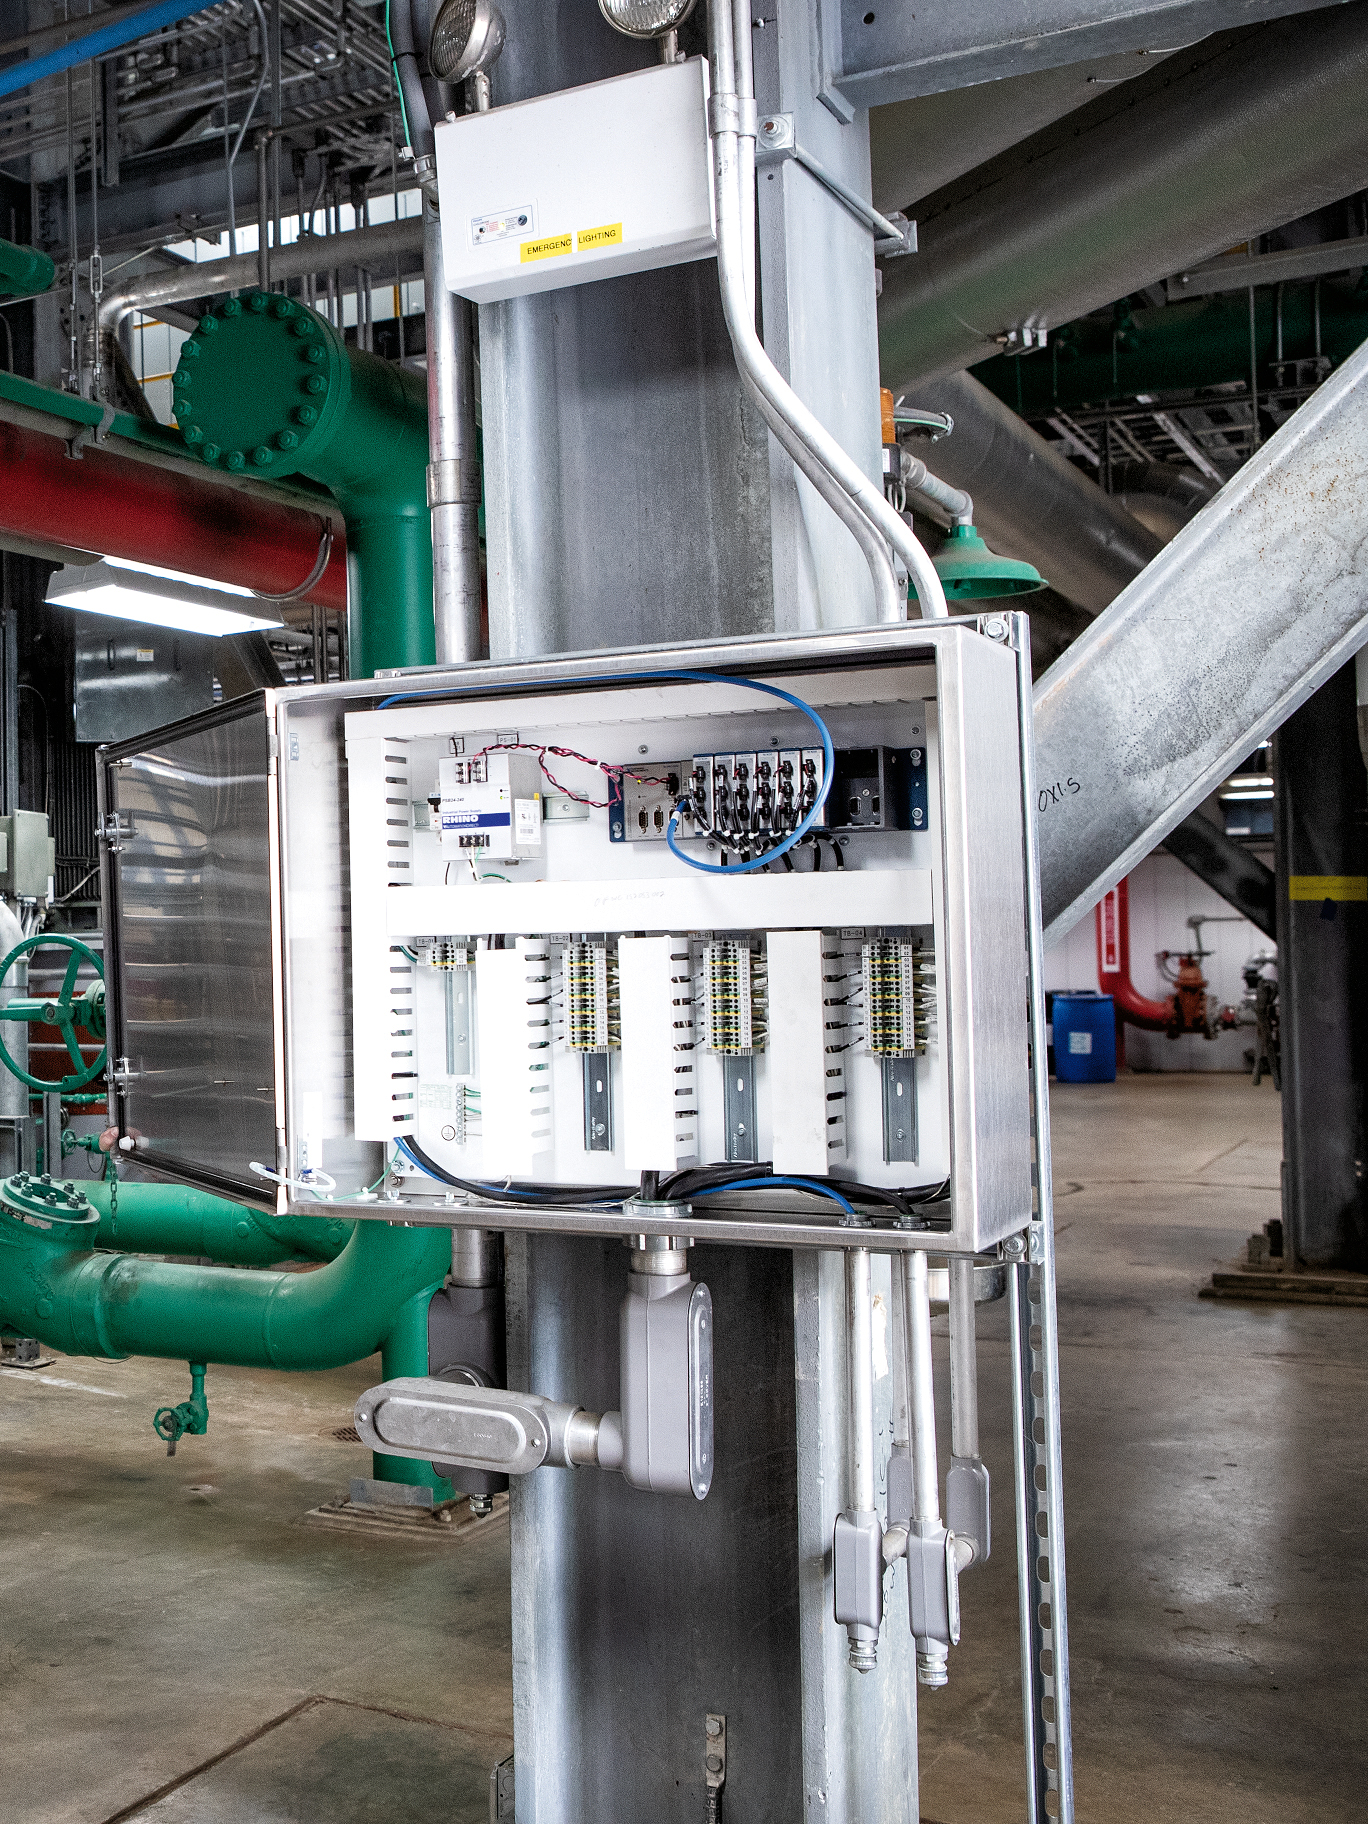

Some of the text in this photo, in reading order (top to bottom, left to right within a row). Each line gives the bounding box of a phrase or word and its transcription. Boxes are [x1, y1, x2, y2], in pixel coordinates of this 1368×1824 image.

[527, 229, 616, 255] EMERGENC LIGHTING
[442, 815, 479, 824] RHINO
